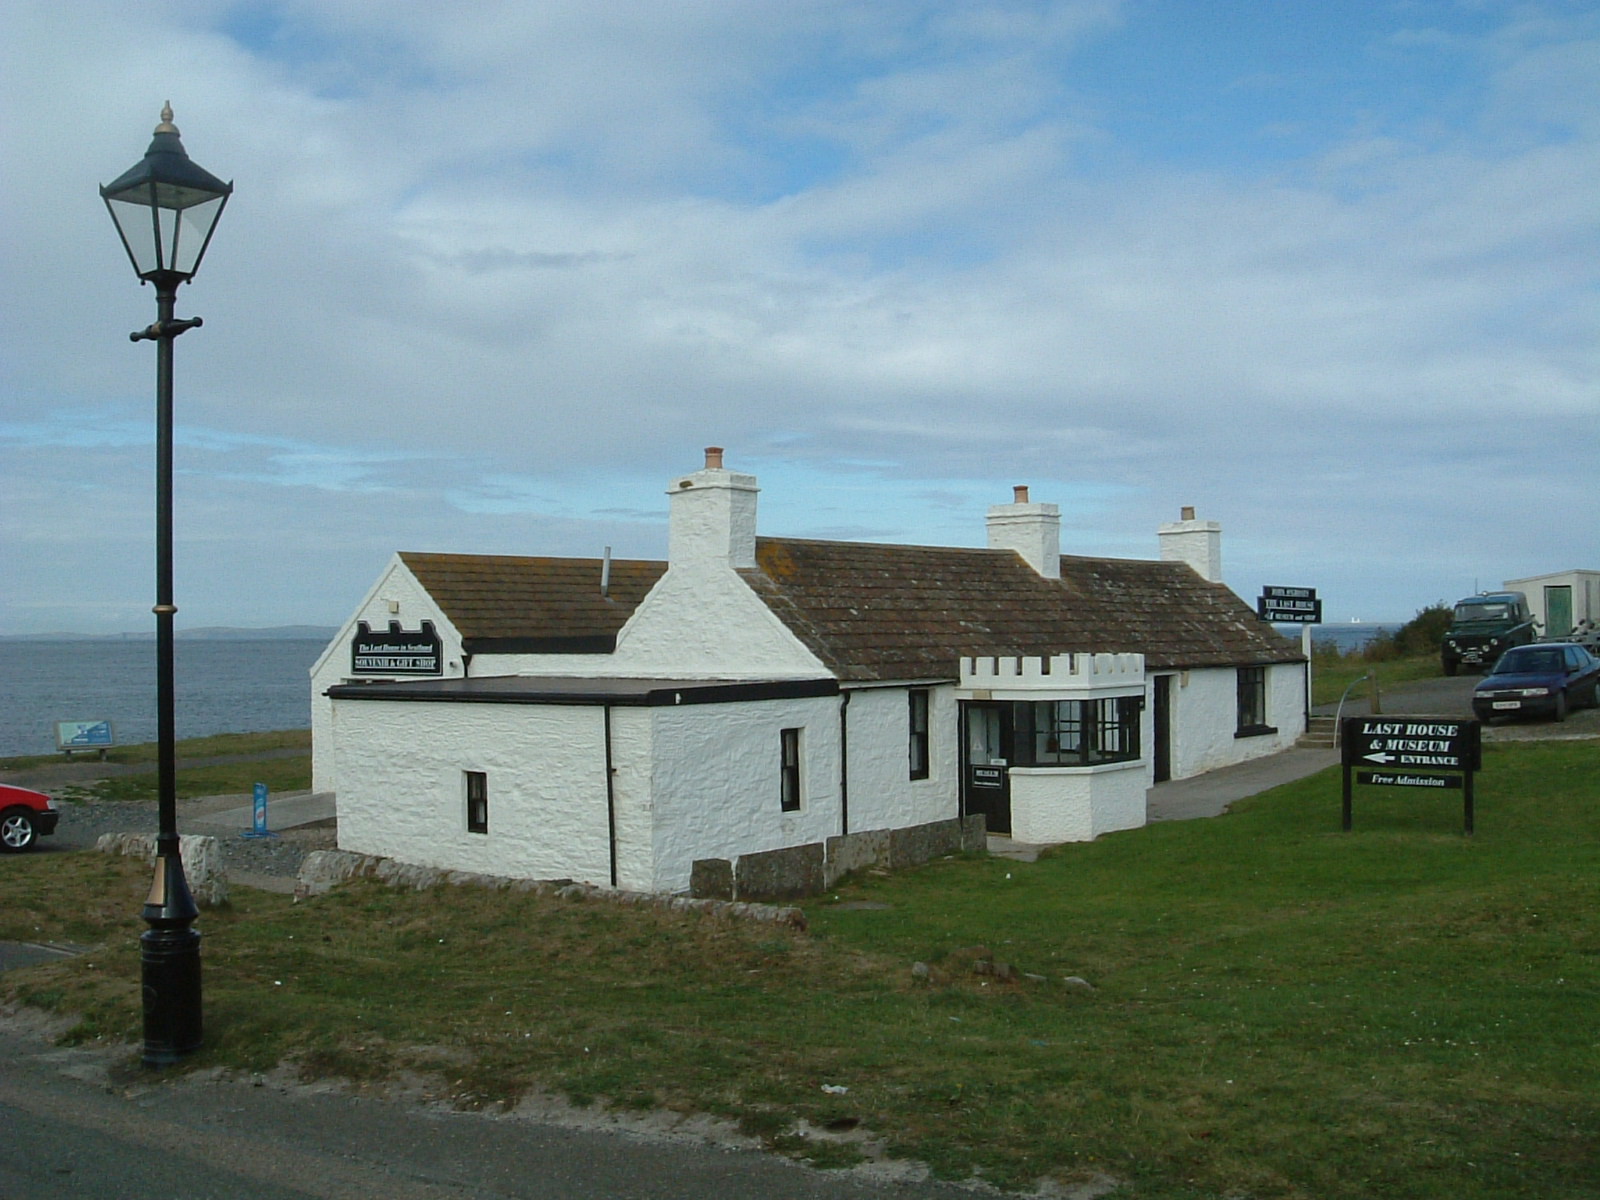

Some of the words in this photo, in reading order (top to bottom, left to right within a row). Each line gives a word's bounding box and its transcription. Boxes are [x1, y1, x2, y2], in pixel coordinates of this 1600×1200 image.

[1265, 599, 1277, 607] THE
[1279, 600, 1293, 608] LAST
[1295, 600, 1314, 609] HOUSE
[355, 658, 389, 667] SOUVENIR
[390, 659, 395, 667] &
[397, 658, 412, 667] GIFT
[416, 658, 436, 668] SHOP
[1362, 723, 1403, 735] LAST
[1406, 724, 1458, 737] HOUSE
[1369, 739, 1382, 750] &
[1385, 739, 1451, 752] MUSEUM
[1400, 755, 1459, 765] ENTRANCE
[1372, 774, 1393, 784] Free
[1395, 775, 1445, 786] Admission
